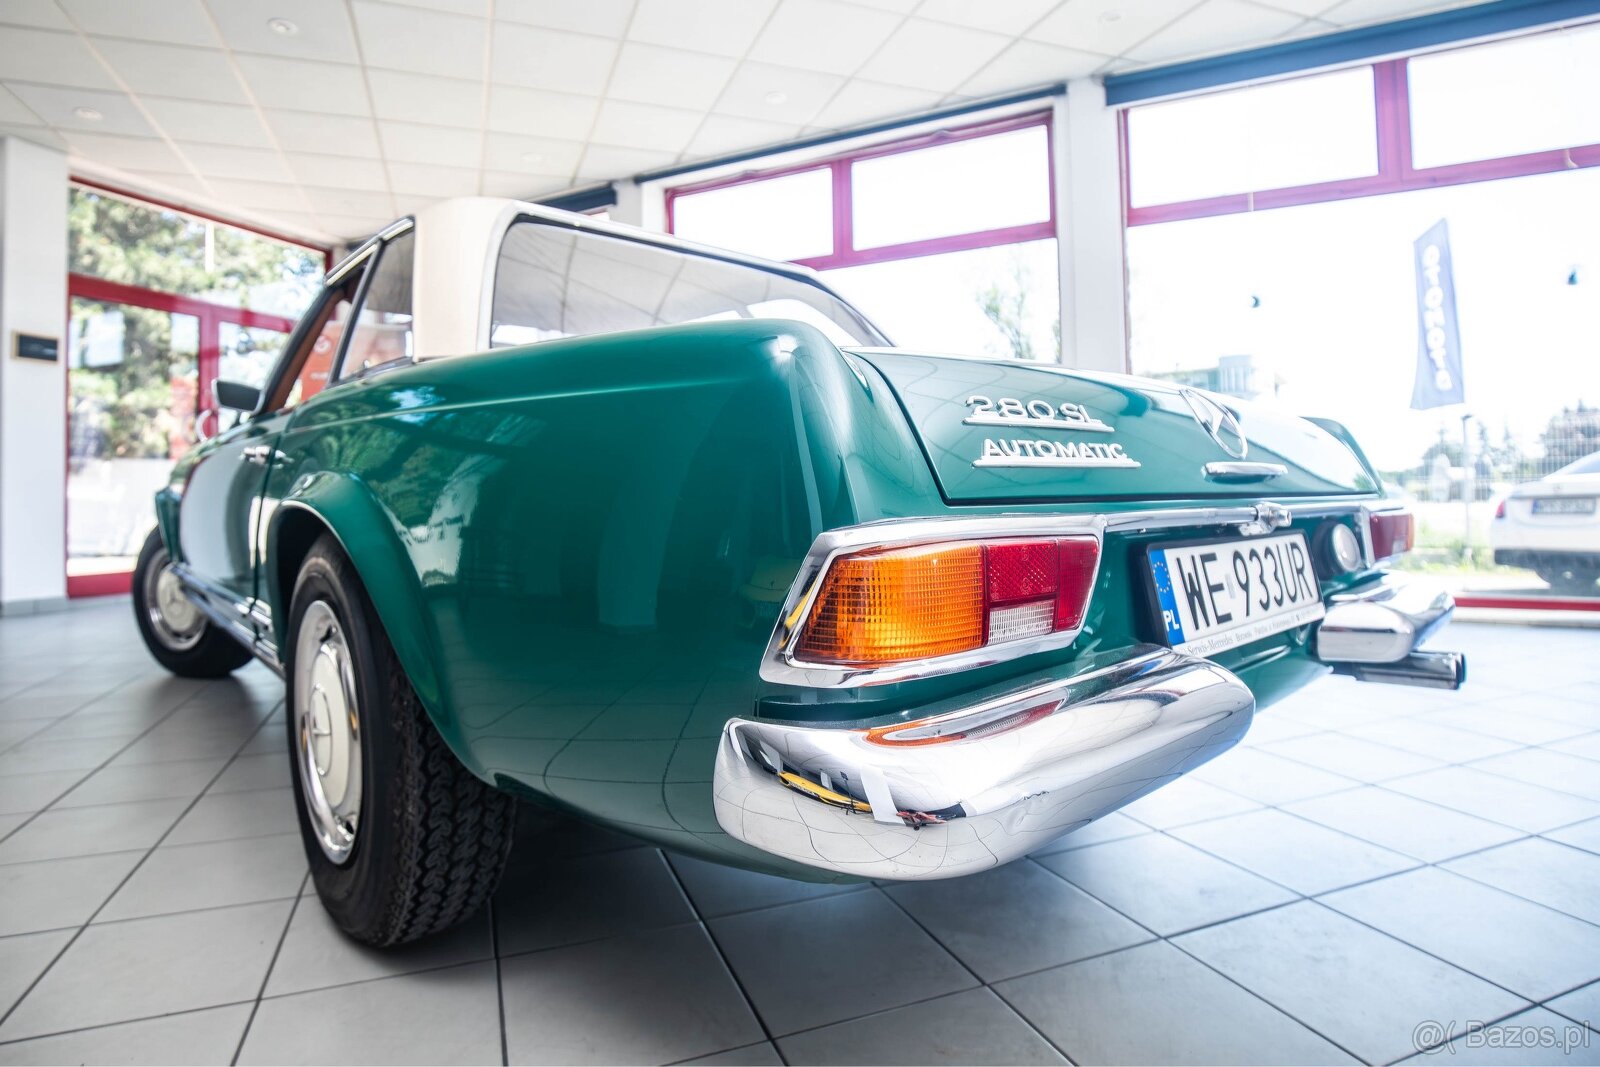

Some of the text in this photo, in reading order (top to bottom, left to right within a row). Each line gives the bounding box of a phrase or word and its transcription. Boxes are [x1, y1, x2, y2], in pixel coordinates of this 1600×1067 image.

[966, 395, 1096, 424] 280 SL
[982, 437, 1127, 460] AUTOMATIC
[1176, 551, 1234, 631] WE
[1232, 541, 1314, 617] 933UR
[1163, 609, 1180, 632] PL
